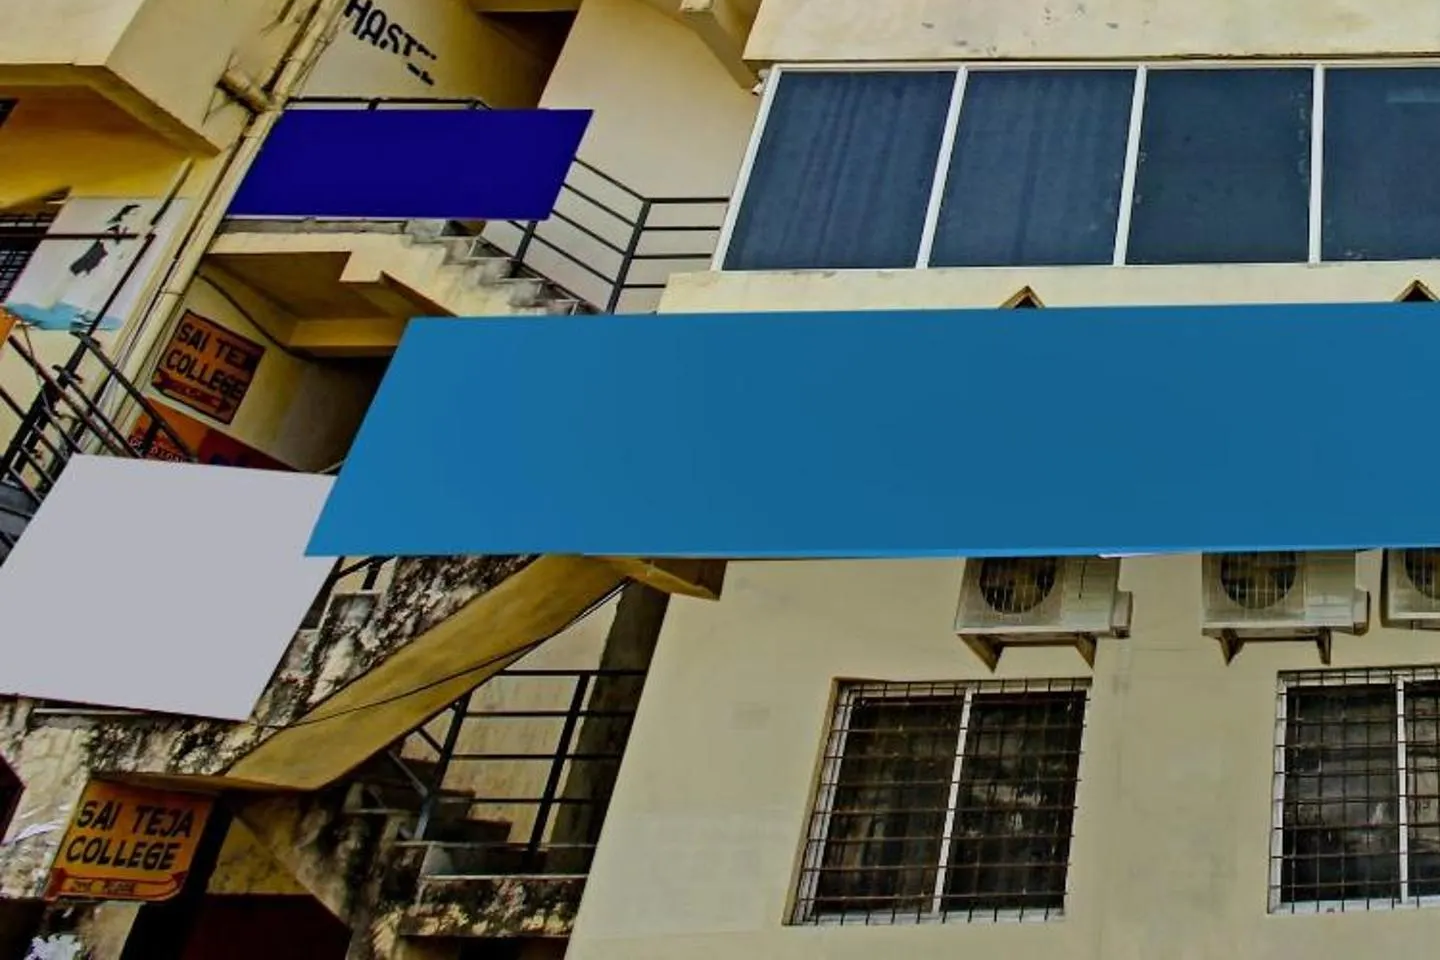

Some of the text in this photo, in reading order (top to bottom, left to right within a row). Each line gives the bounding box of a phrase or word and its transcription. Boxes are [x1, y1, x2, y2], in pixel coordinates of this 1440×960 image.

[179, 322, 211, 353] SAI
[166, 348, 246, 401] COLLEGE
[77, 800, 194, 838] SAI TEJA
[65, 836, 181, 871] COLLEGE
